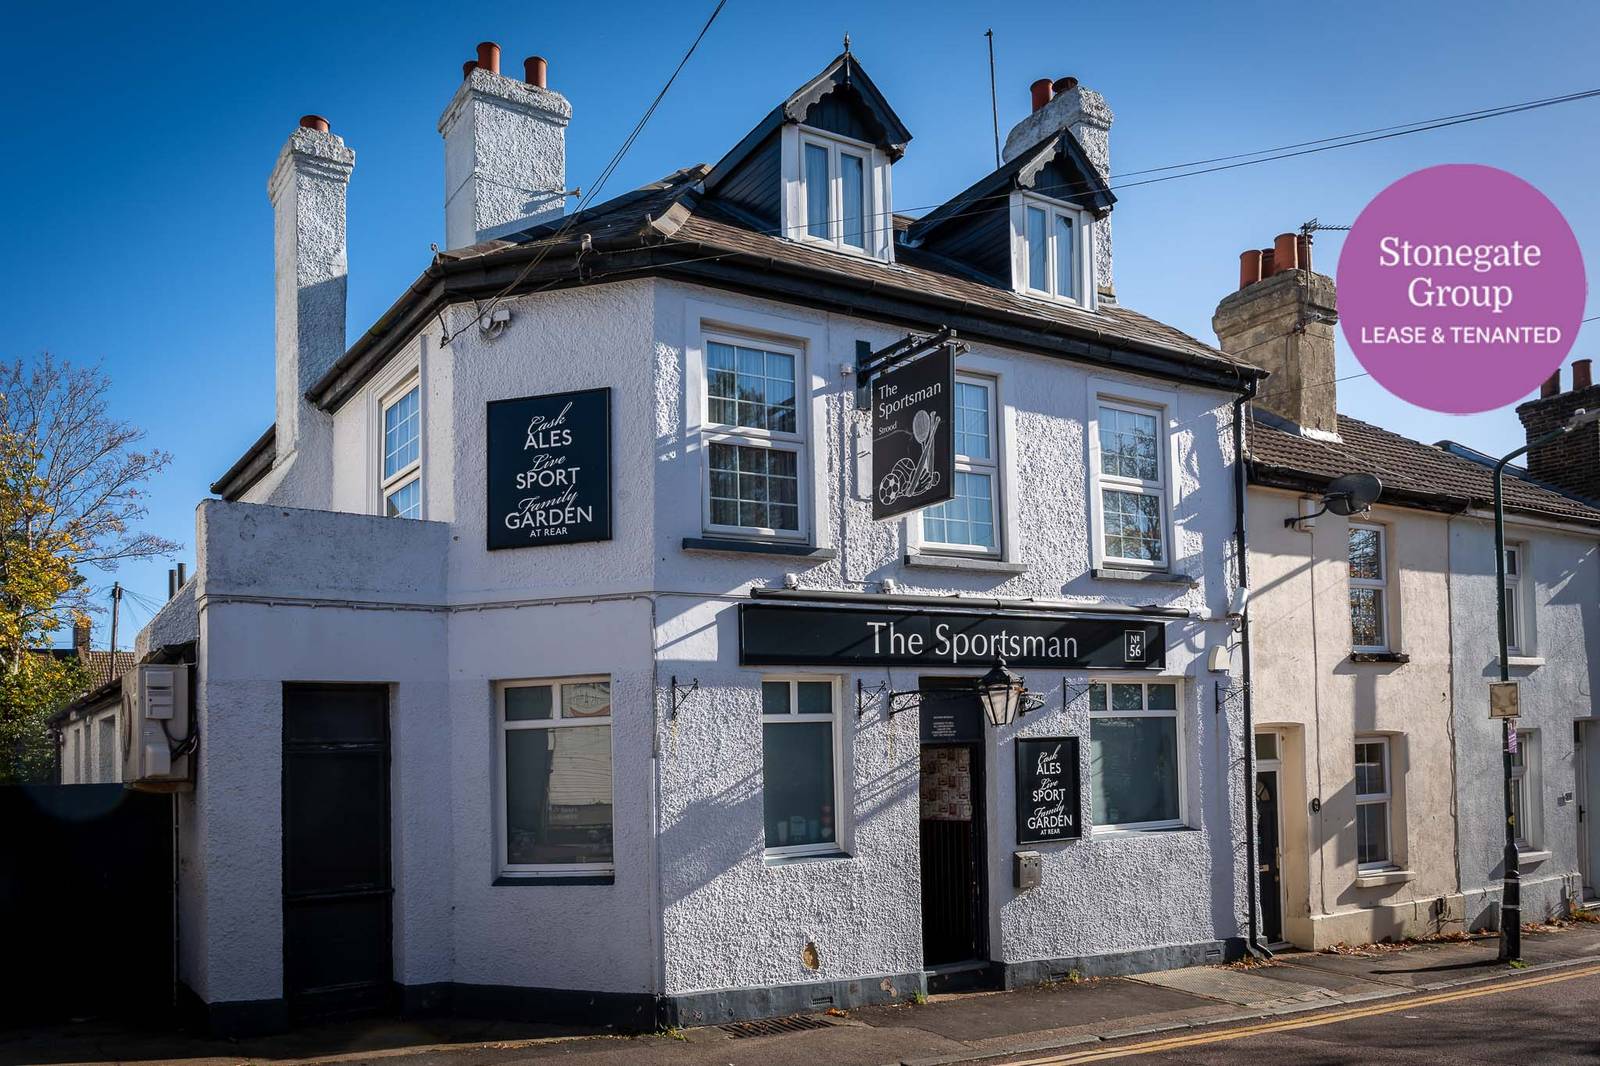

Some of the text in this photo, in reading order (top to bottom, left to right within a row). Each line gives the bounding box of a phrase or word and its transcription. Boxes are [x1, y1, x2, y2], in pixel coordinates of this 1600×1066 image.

[878, 384, 898, 399] The
[878, 382, 941, 420] Sportsman
[527, 401, 573, 435] Cask
[878, 421, 897, 435] Strood
[523, 429, 573, 450] ALES
[528, 453, 567, 474] Live
[516, 467, 581, 490] SPORT
[517, 483, 578, 516] Family
[504, 505, 592, 529] GARDEN
[529, 526, 568, 538] AT REAR
[866, 621, 1079, 664] The Sportsman
[1129, 644, 1142, 657] 56
[1037, 744, 1061, 765] Cask
[1036, 762, 1061, 775] ALES
[1040, 777, 1059, 790] Live
[1032, 788, 1066, 802] SPORT
[1034, 800, 1065, 820] Family
[1027, 815, 1073, 829] GARDEN
